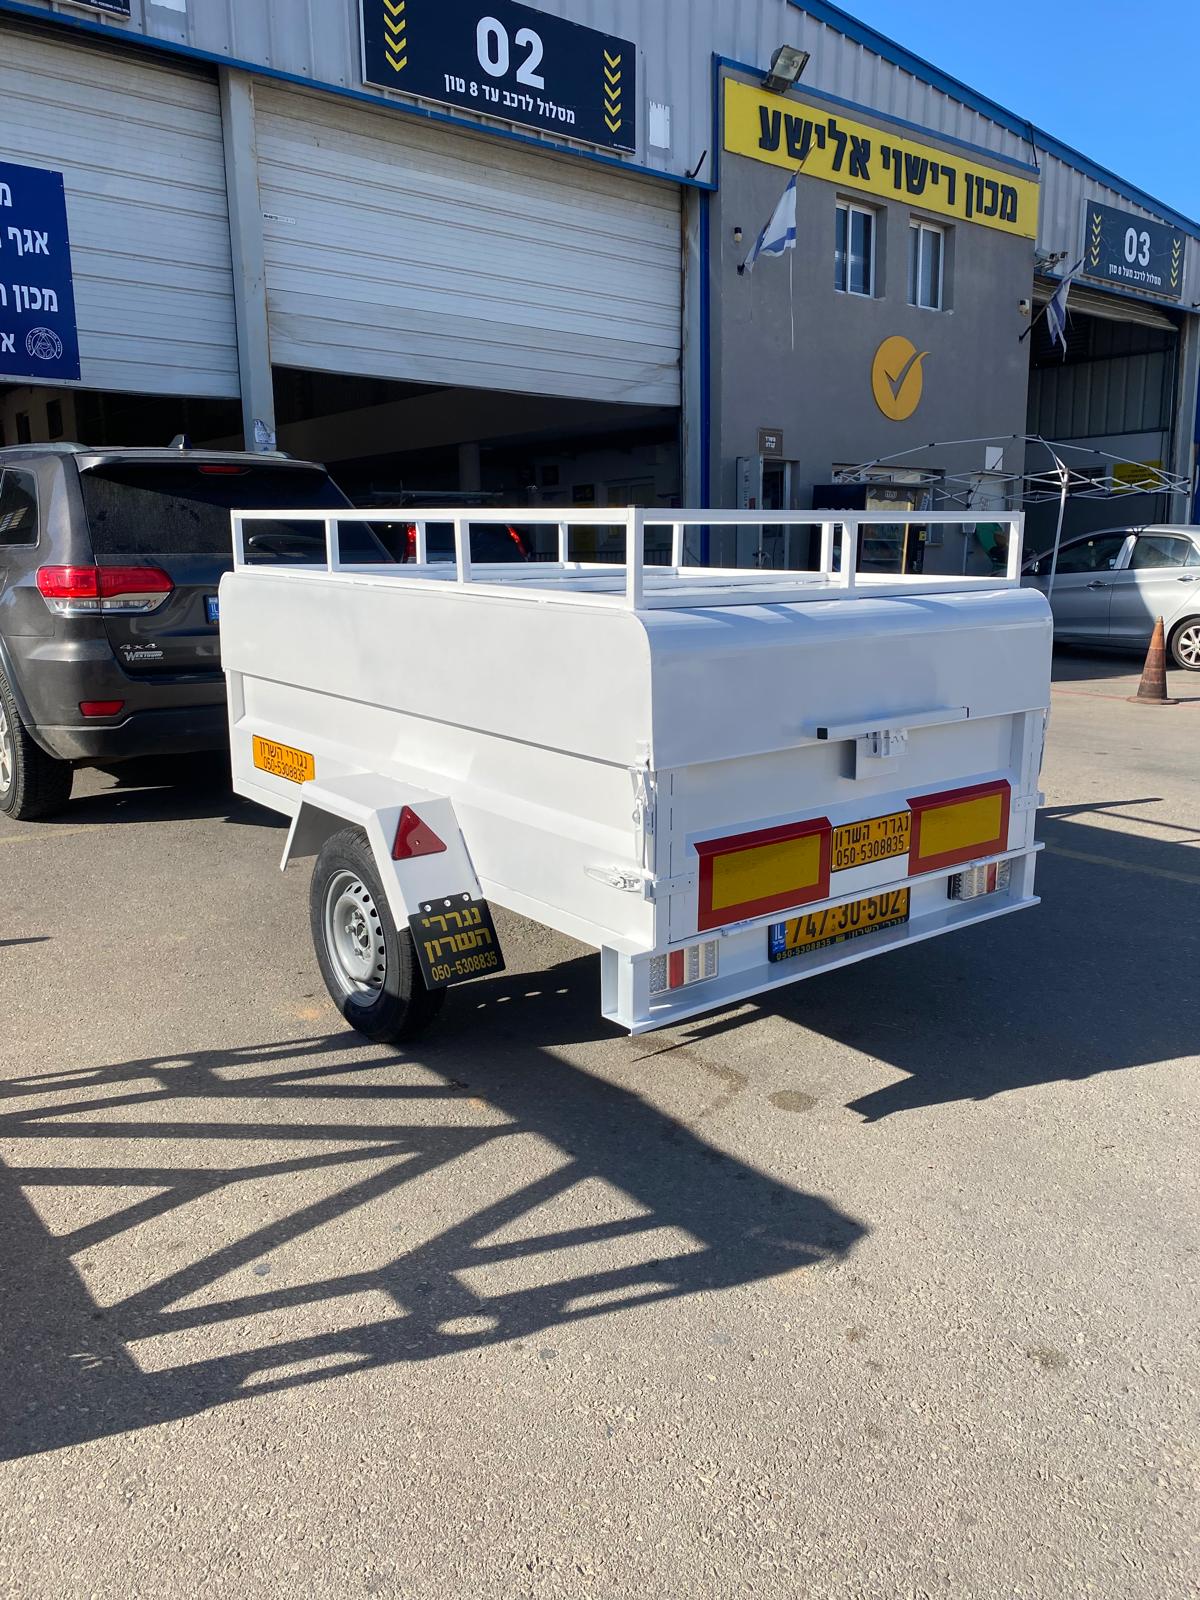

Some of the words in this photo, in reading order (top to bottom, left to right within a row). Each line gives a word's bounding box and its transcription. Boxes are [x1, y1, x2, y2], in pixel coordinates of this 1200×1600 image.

[476, 16, 545, 90] 02
[444, 73, 465, 93] טון
[469, 81, 478, 97] 8
[482, 84, 499, 103] עד
[502, 90, 534, 112] לרכב
[537, 98, 576, 125] מסלול
[758, 105, 871, 181] אלישע
[880, 144, 956, 205] רישוי
[965, 172, 1018, 224] מכון
[7, 226, 50, 256] אגף
[1124, 227, 1151, 267] 03
[1118, 266, 1122, 276] 8
[1133, 270, 1146, 282] לרכב
[1147, 272, 1161, 286] מסלול
[13, 284, 59, 313] מכון
[260, 741, 283, 761] השרון
[286, 750, 308, 770] נגררי
[263, 756, 306, 781] 050-5308835
[835, 824, 870, 850] השרון
[878, 815, 909, 836] נגררי
[836, 834, 905, 866] 050-5308835
[421, 907, 482, 932] נגררי
[774, 924, 783, 940] IL
[423, 927, 492, 964] השרון
[431, 951, 498, 981] 050-5308835
